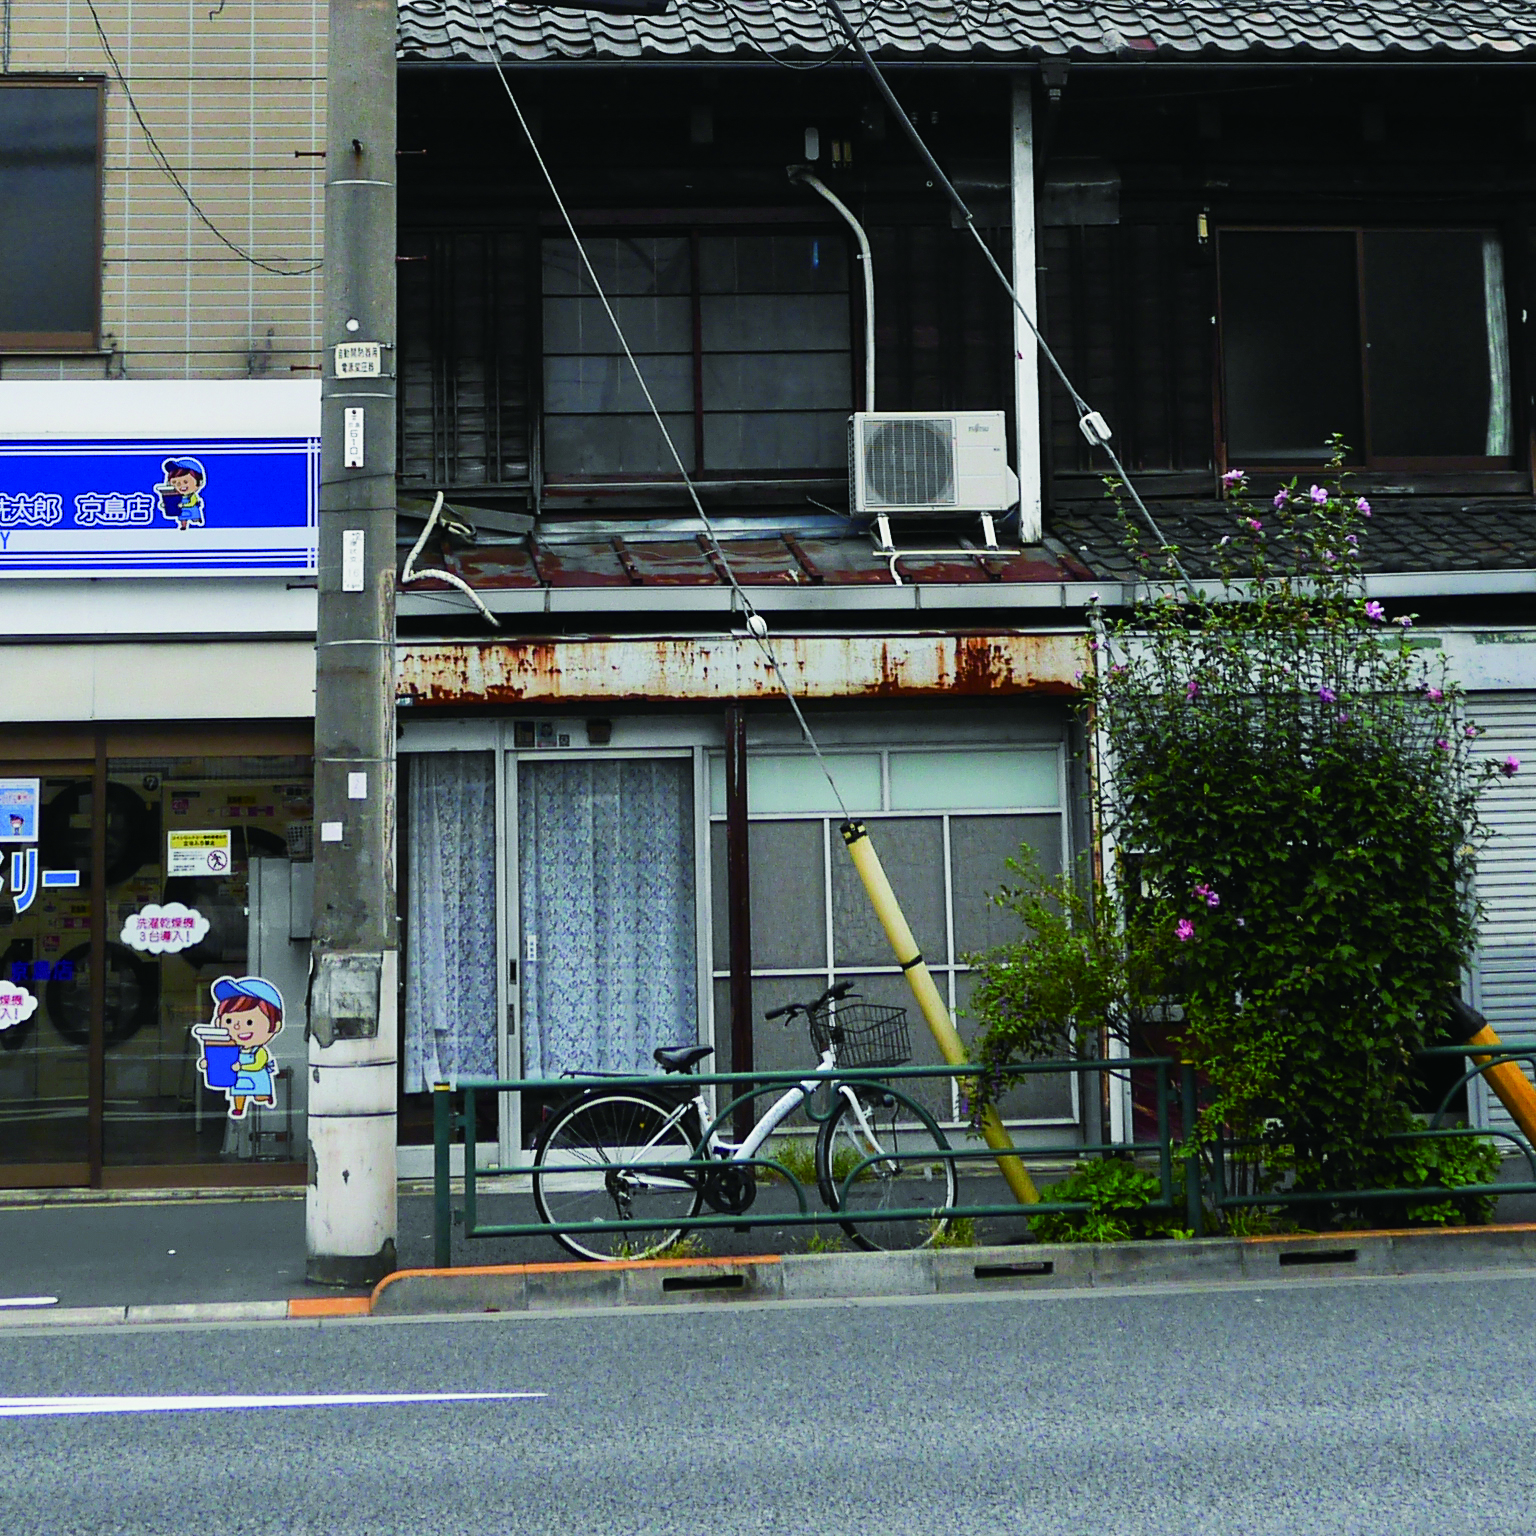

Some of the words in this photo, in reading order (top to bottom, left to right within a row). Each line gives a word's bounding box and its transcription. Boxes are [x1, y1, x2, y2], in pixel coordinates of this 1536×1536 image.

[74, 493, 155, 526] 京島店
[136, 917, 195, 930] 洗濯乾燥機
[10, 960, 76, 982] 京島店
